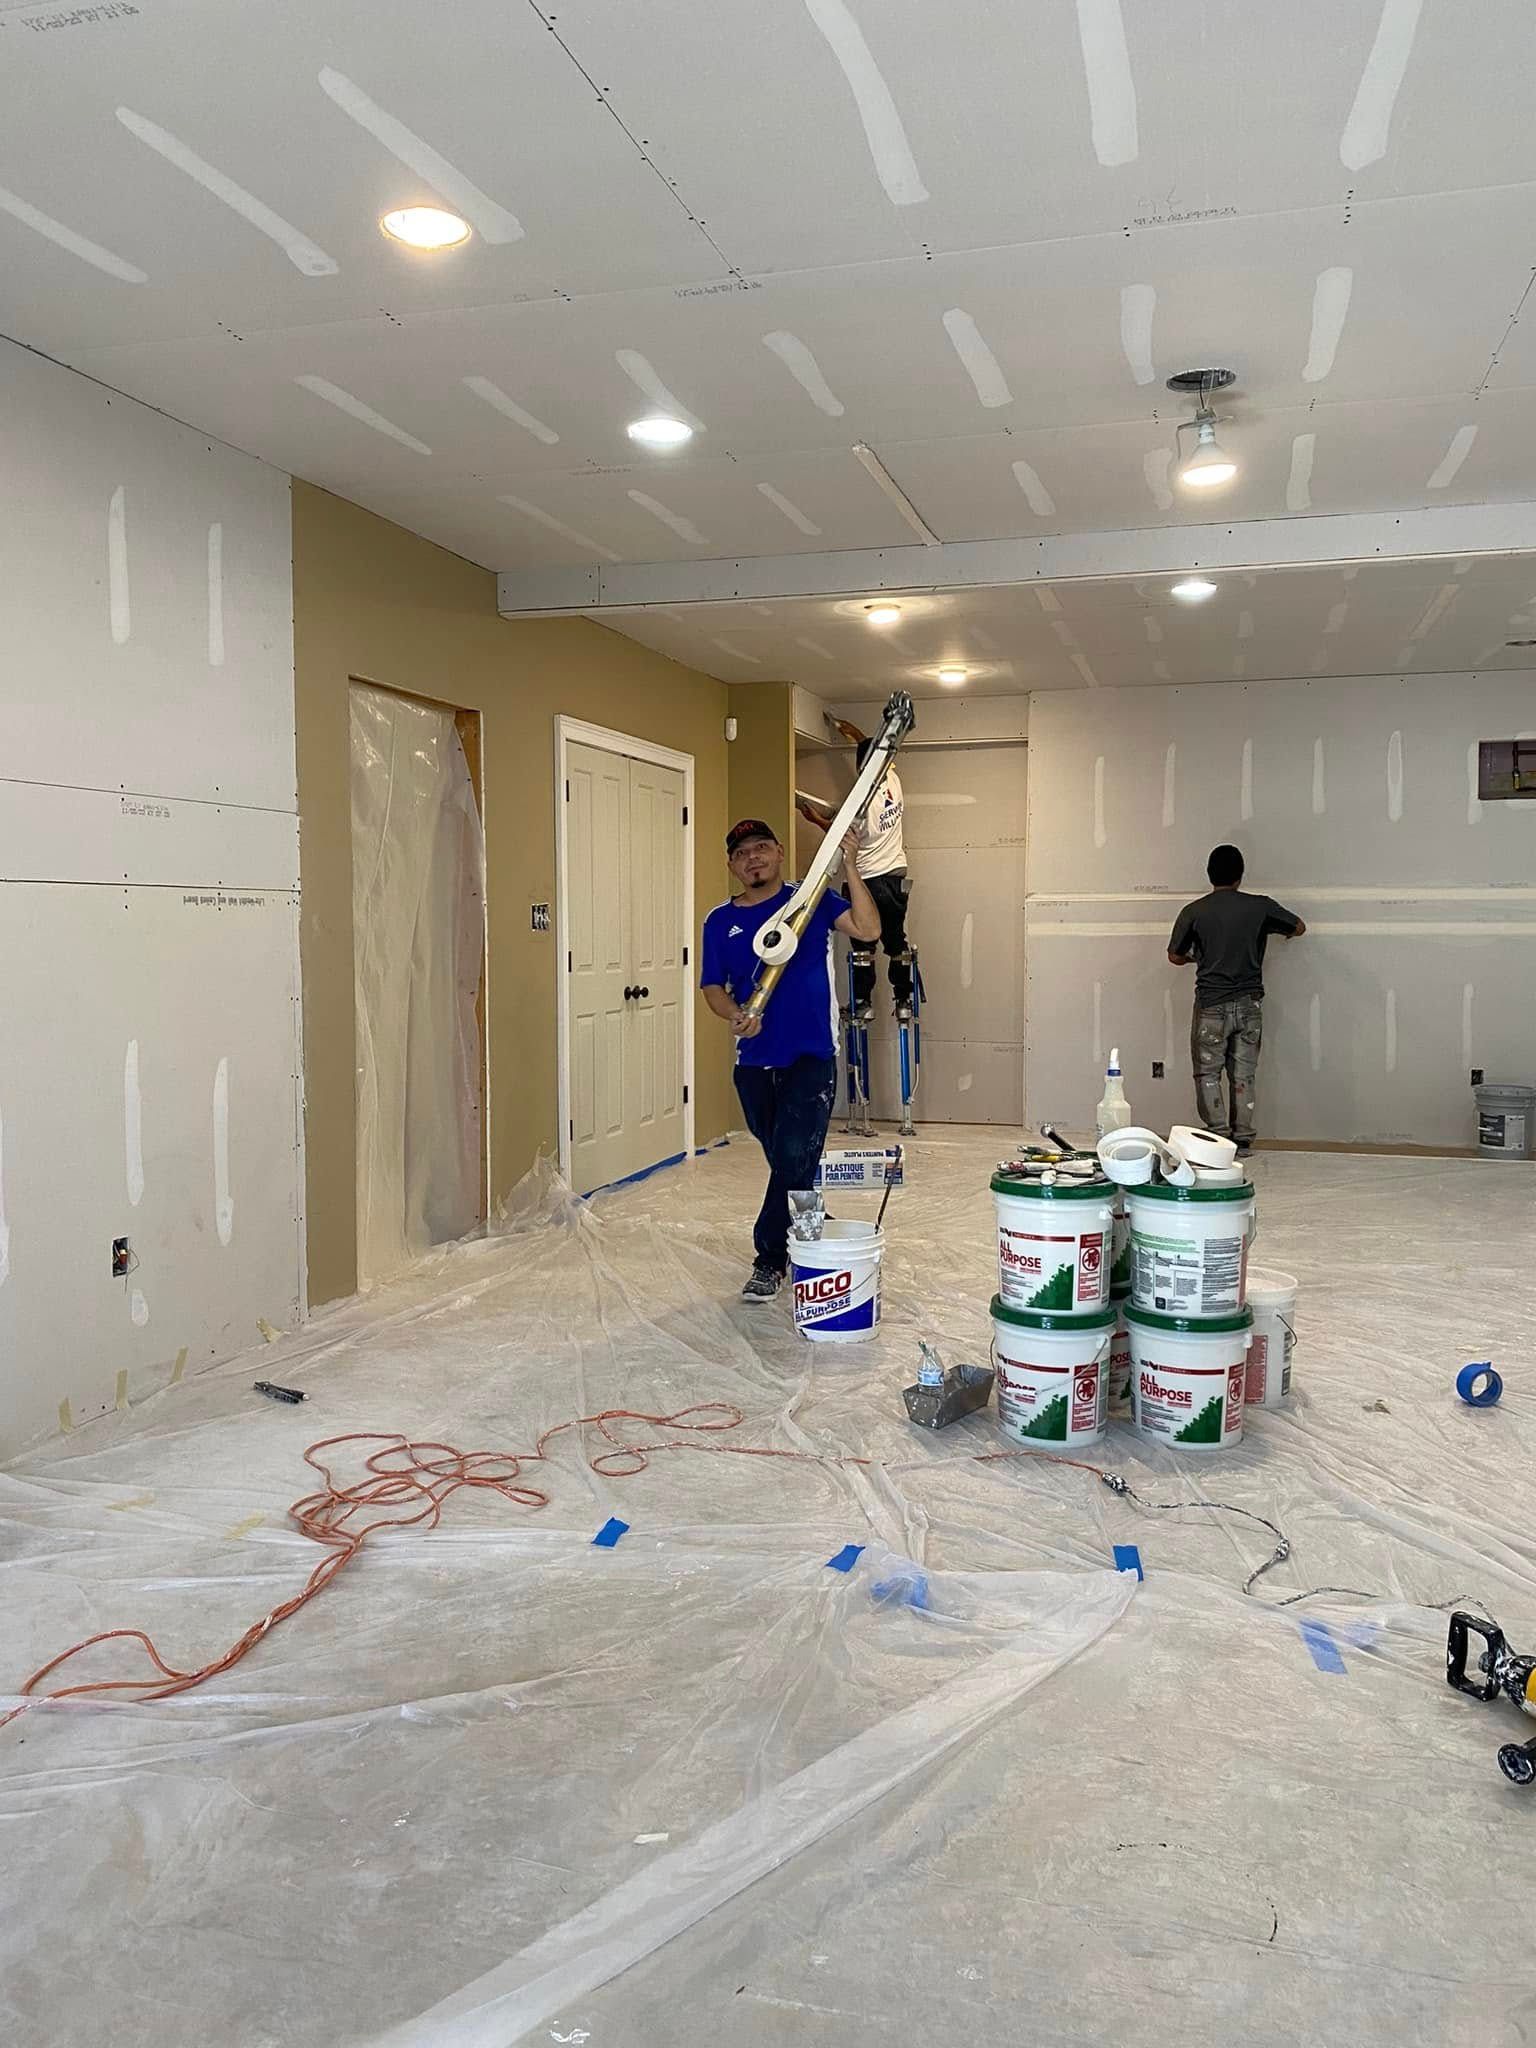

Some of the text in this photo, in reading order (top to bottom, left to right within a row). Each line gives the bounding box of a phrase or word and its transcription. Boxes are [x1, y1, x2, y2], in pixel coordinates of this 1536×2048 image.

[825, 1163, 865, 1172] PLASTIQUE
[825, 1172, 839, 1181] POUR
[999, 1239, 1012, 1253] ALL
[1000, 1251, 1042, 1268] PURPOSE
[806, 1297, 852, 1316] PURPOSE
[1140, 1372, 1158, 1386] ALL
[1140, 1383, 1192, 1403] PURPOSE
